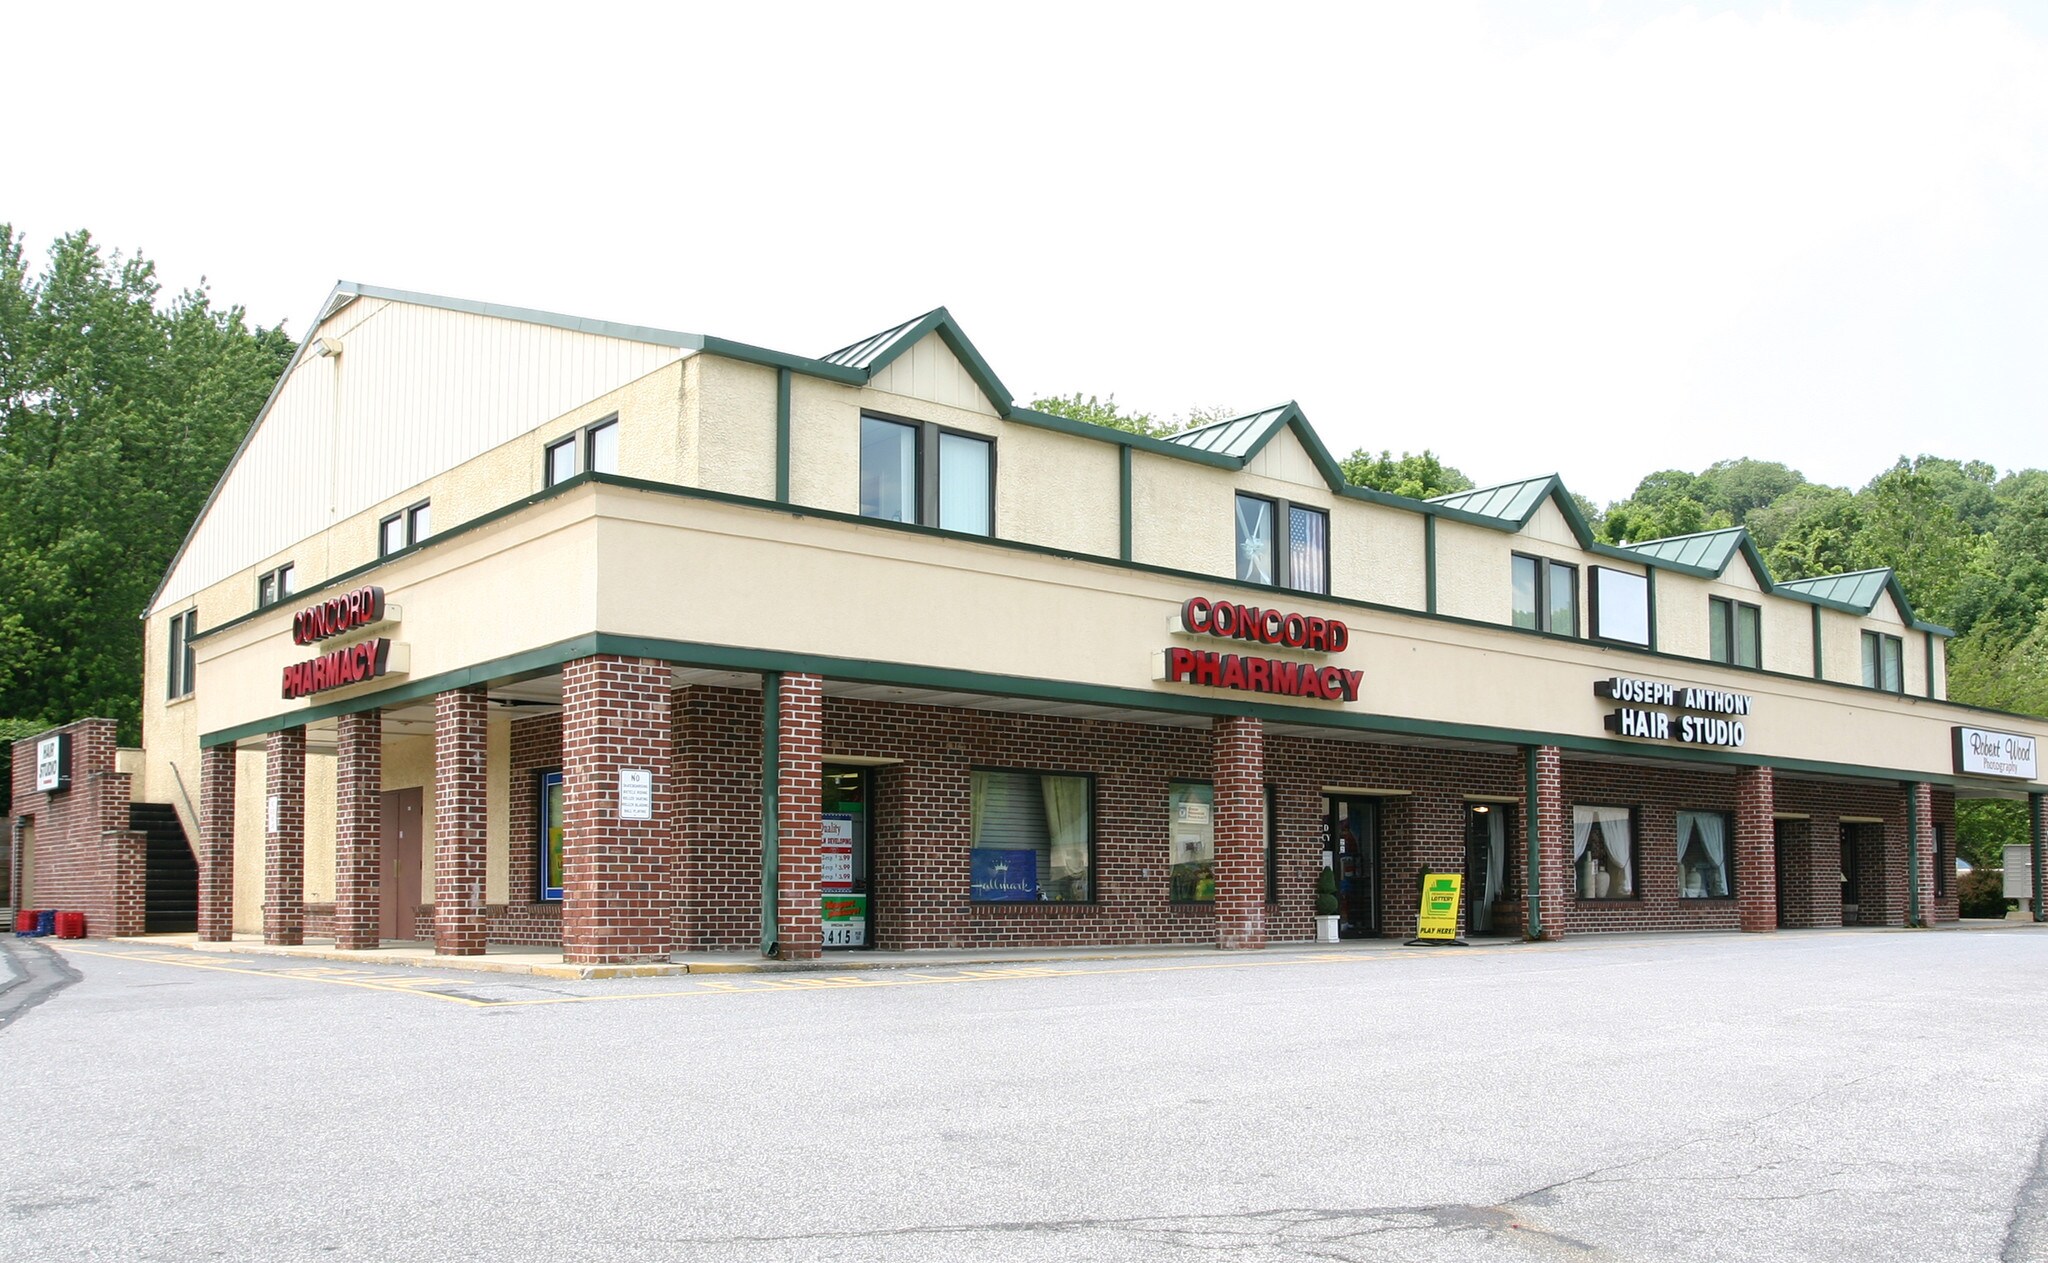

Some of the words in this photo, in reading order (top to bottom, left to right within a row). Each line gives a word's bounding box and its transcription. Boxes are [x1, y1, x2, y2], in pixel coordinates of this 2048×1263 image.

[293, 585, 382, 646] CONCORD
[1184, 597, 1348, 653] CONCORD
[283, 638, 386, 699] PHARMACY
[1168, 647, 1364, 702] PHARMACY
[1612, 677, 1674, 706] JOSEPH
[1685, 688, 1752, 715] ANTHONY
[1622, 708, 1669, 740] HAIR
[1682, 715, 1745, 747] STUDIO
[1970, 732, 2001, 758] Robert
[2005, 738, 2032, 761] Wood
[631, 774, 641, 782] NO
[1983, 757, 2018, 775] Photography
[971, 875, 1033, 896] Hallmark
